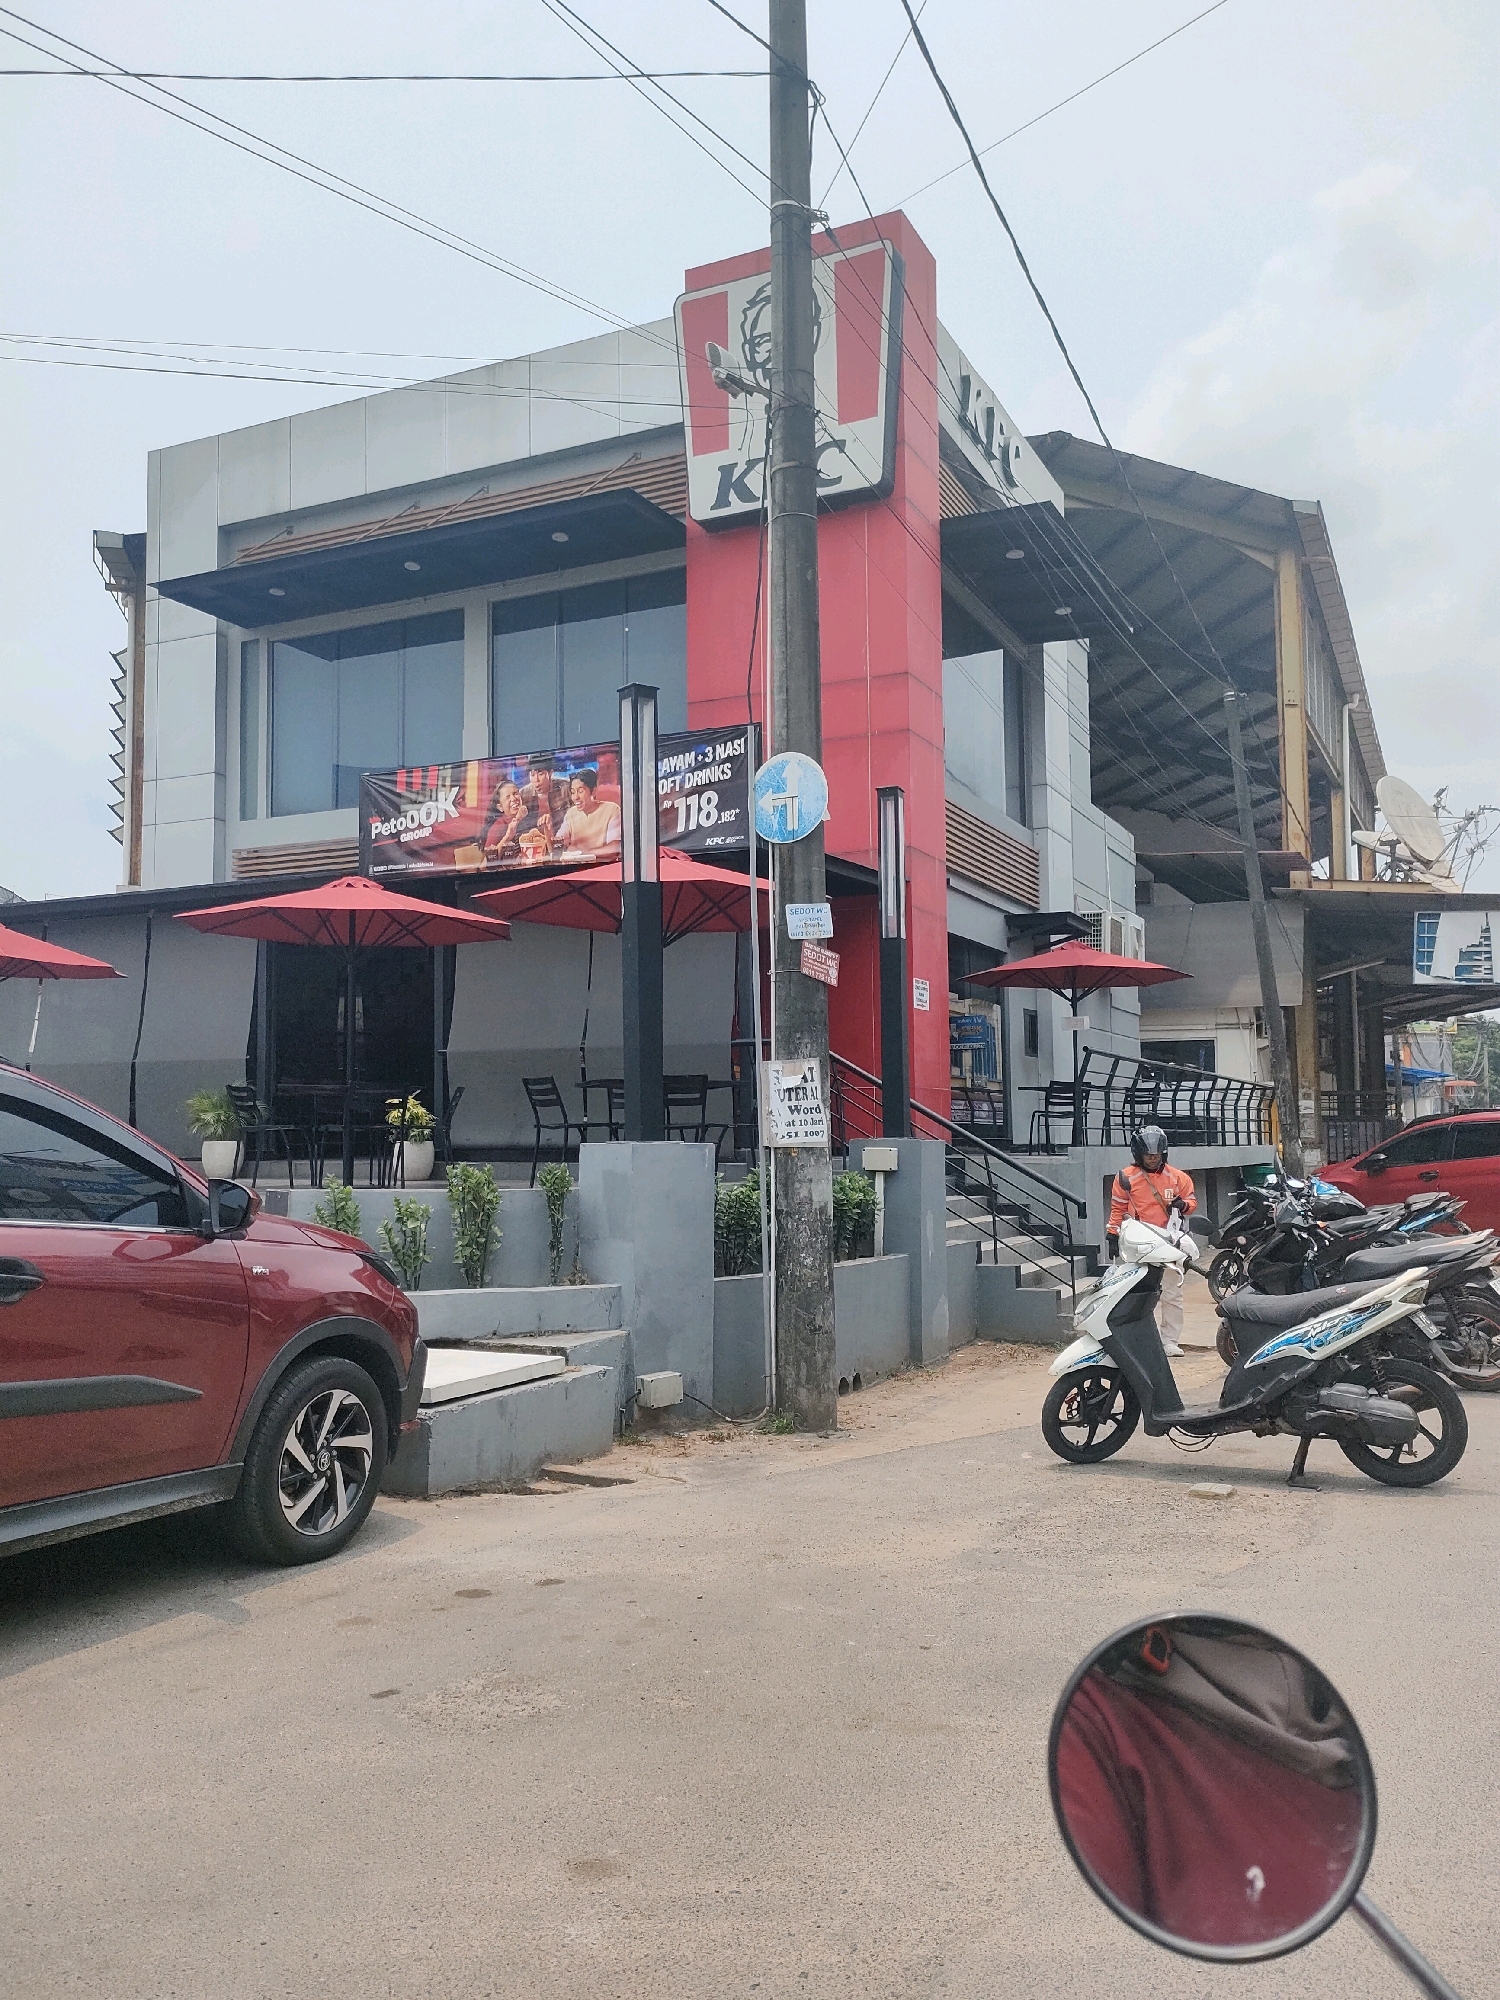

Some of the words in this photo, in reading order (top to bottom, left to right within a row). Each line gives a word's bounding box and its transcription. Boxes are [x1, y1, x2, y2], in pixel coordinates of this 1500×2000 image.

[709, 439, 847, 512] KC
[662, 751, 696, 774] AYAM
[705, 746, 713, 763] 3
[715, 738, 745, 761] NASI
[658, 774, 683, 795] OFT
[684, 762, 732, 789] DRINKS
[400, 826, 432, 843] GROUP
[705, 836, 725, 846] KFC
[789, 907, 815, 916] SEDOT
[803, 948, 826, 962] SEDOT
[826, 957, 838, 969] WC
[787, 1103, 822, 1116] Word
[785, 1119, 796, 1128] at
[798, 1119, 808, 1127] 10
[804, 1130, 825, 1138] 1007
